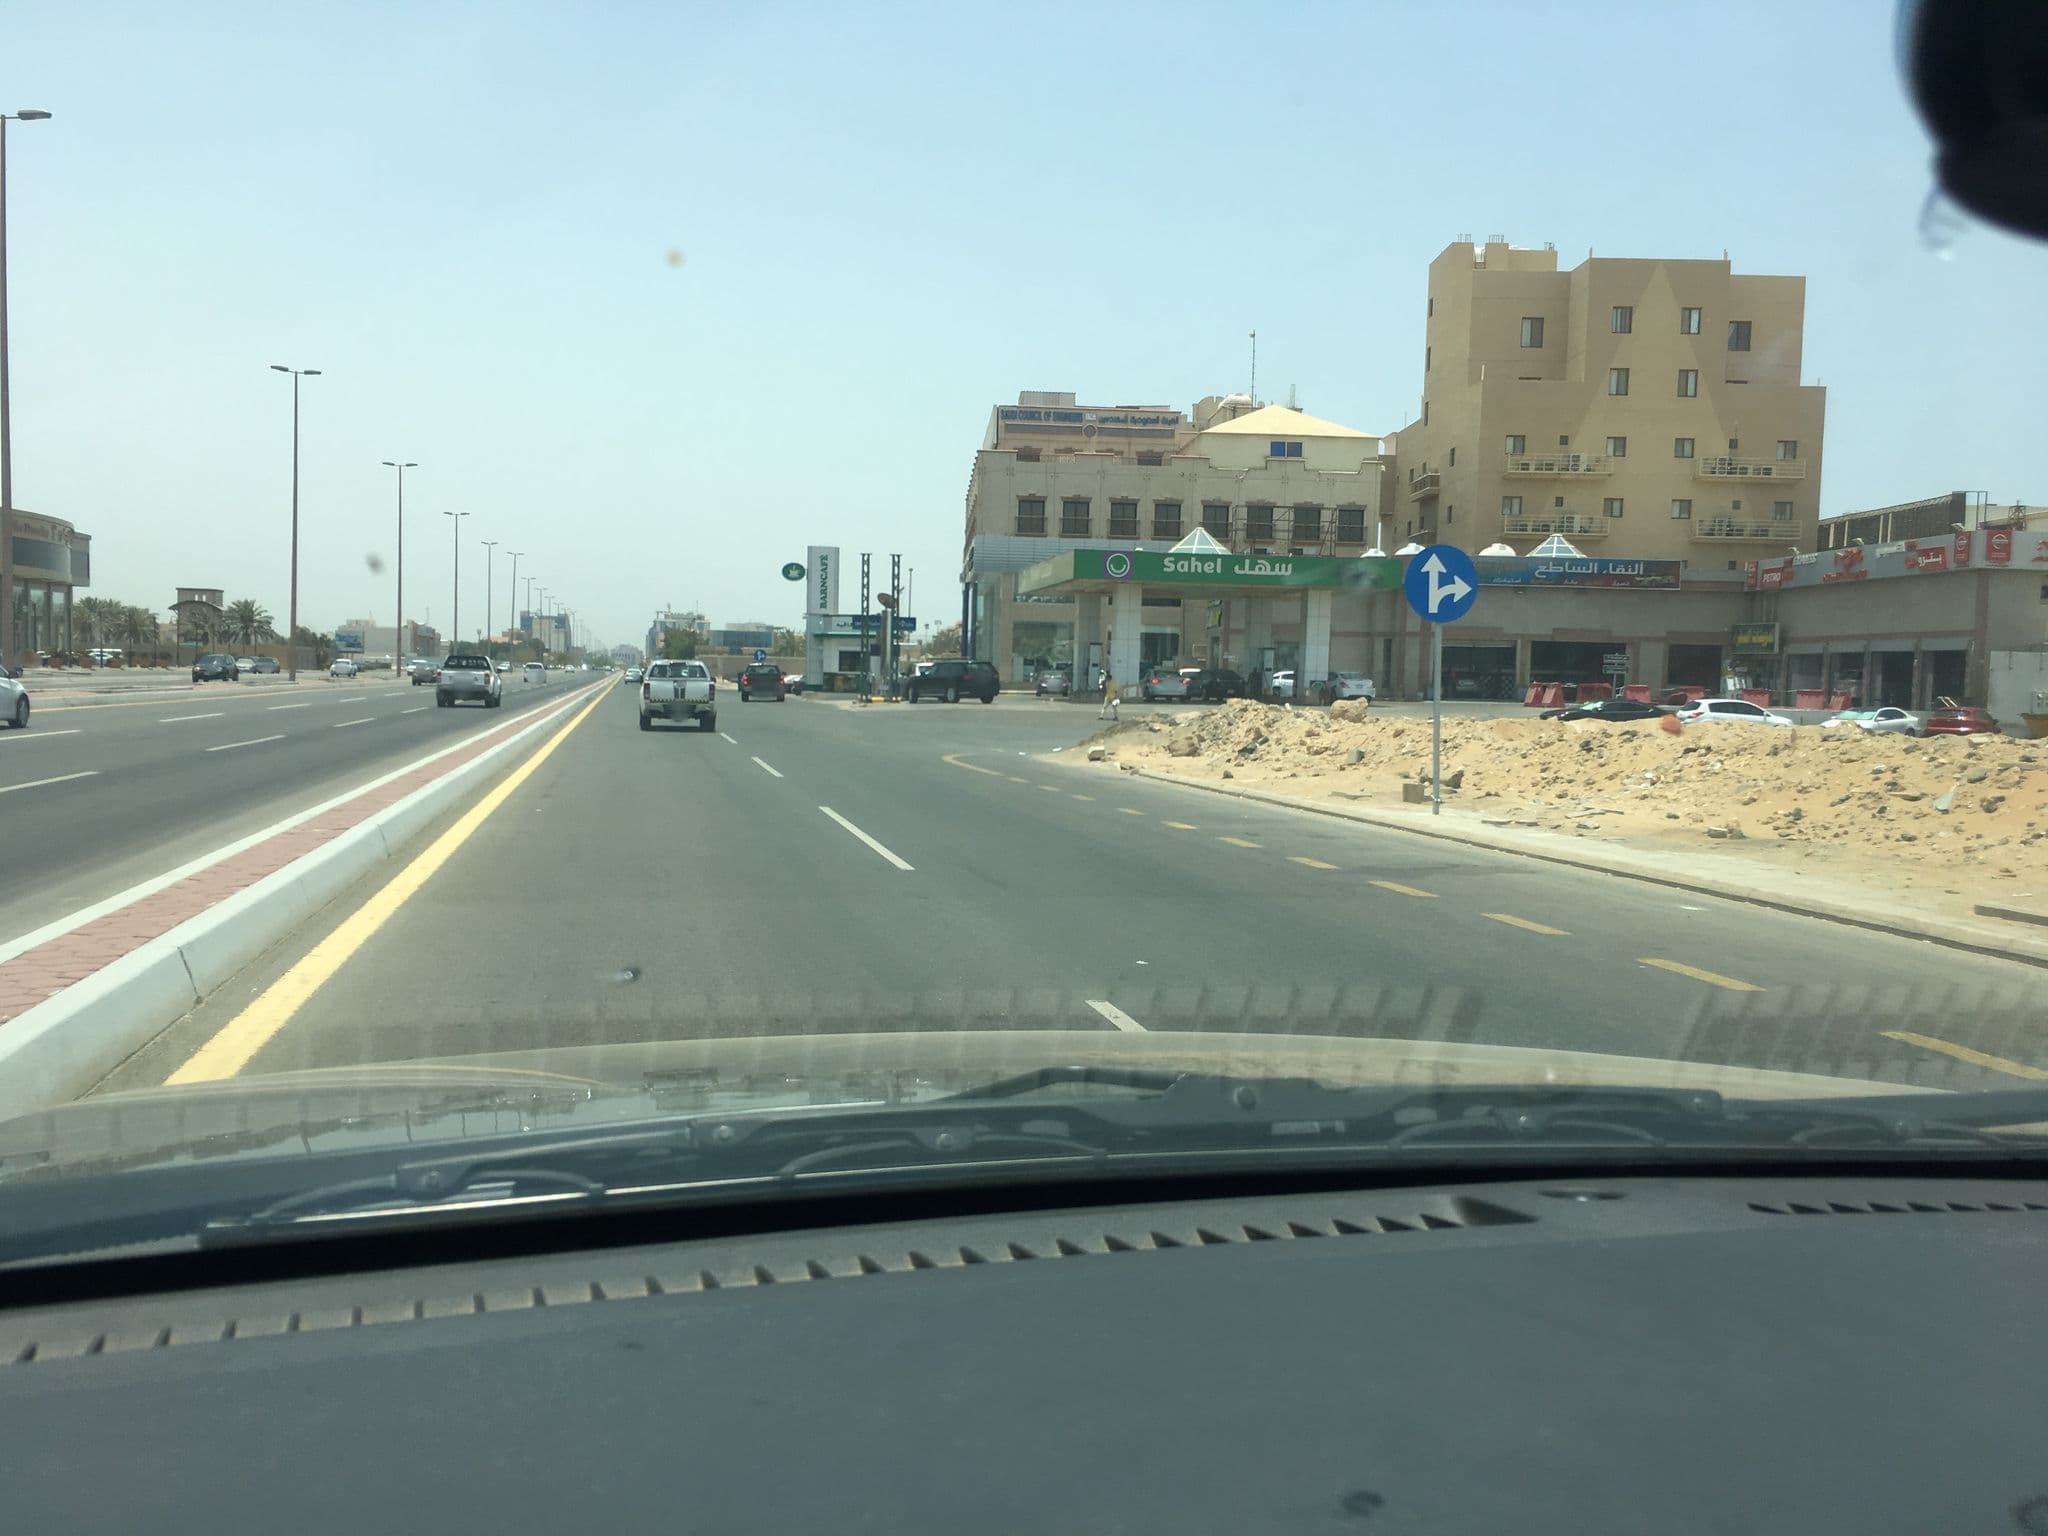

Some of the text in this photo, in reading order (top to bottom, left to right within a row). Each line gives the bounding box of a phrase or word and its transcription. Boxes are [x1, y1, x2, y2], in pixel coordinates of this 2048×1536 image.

[1163, 557, 1222, 574] Sahel
[1233, 559, 1293, 576] سهل
[1535, 561, 1598, 579] الساطع
